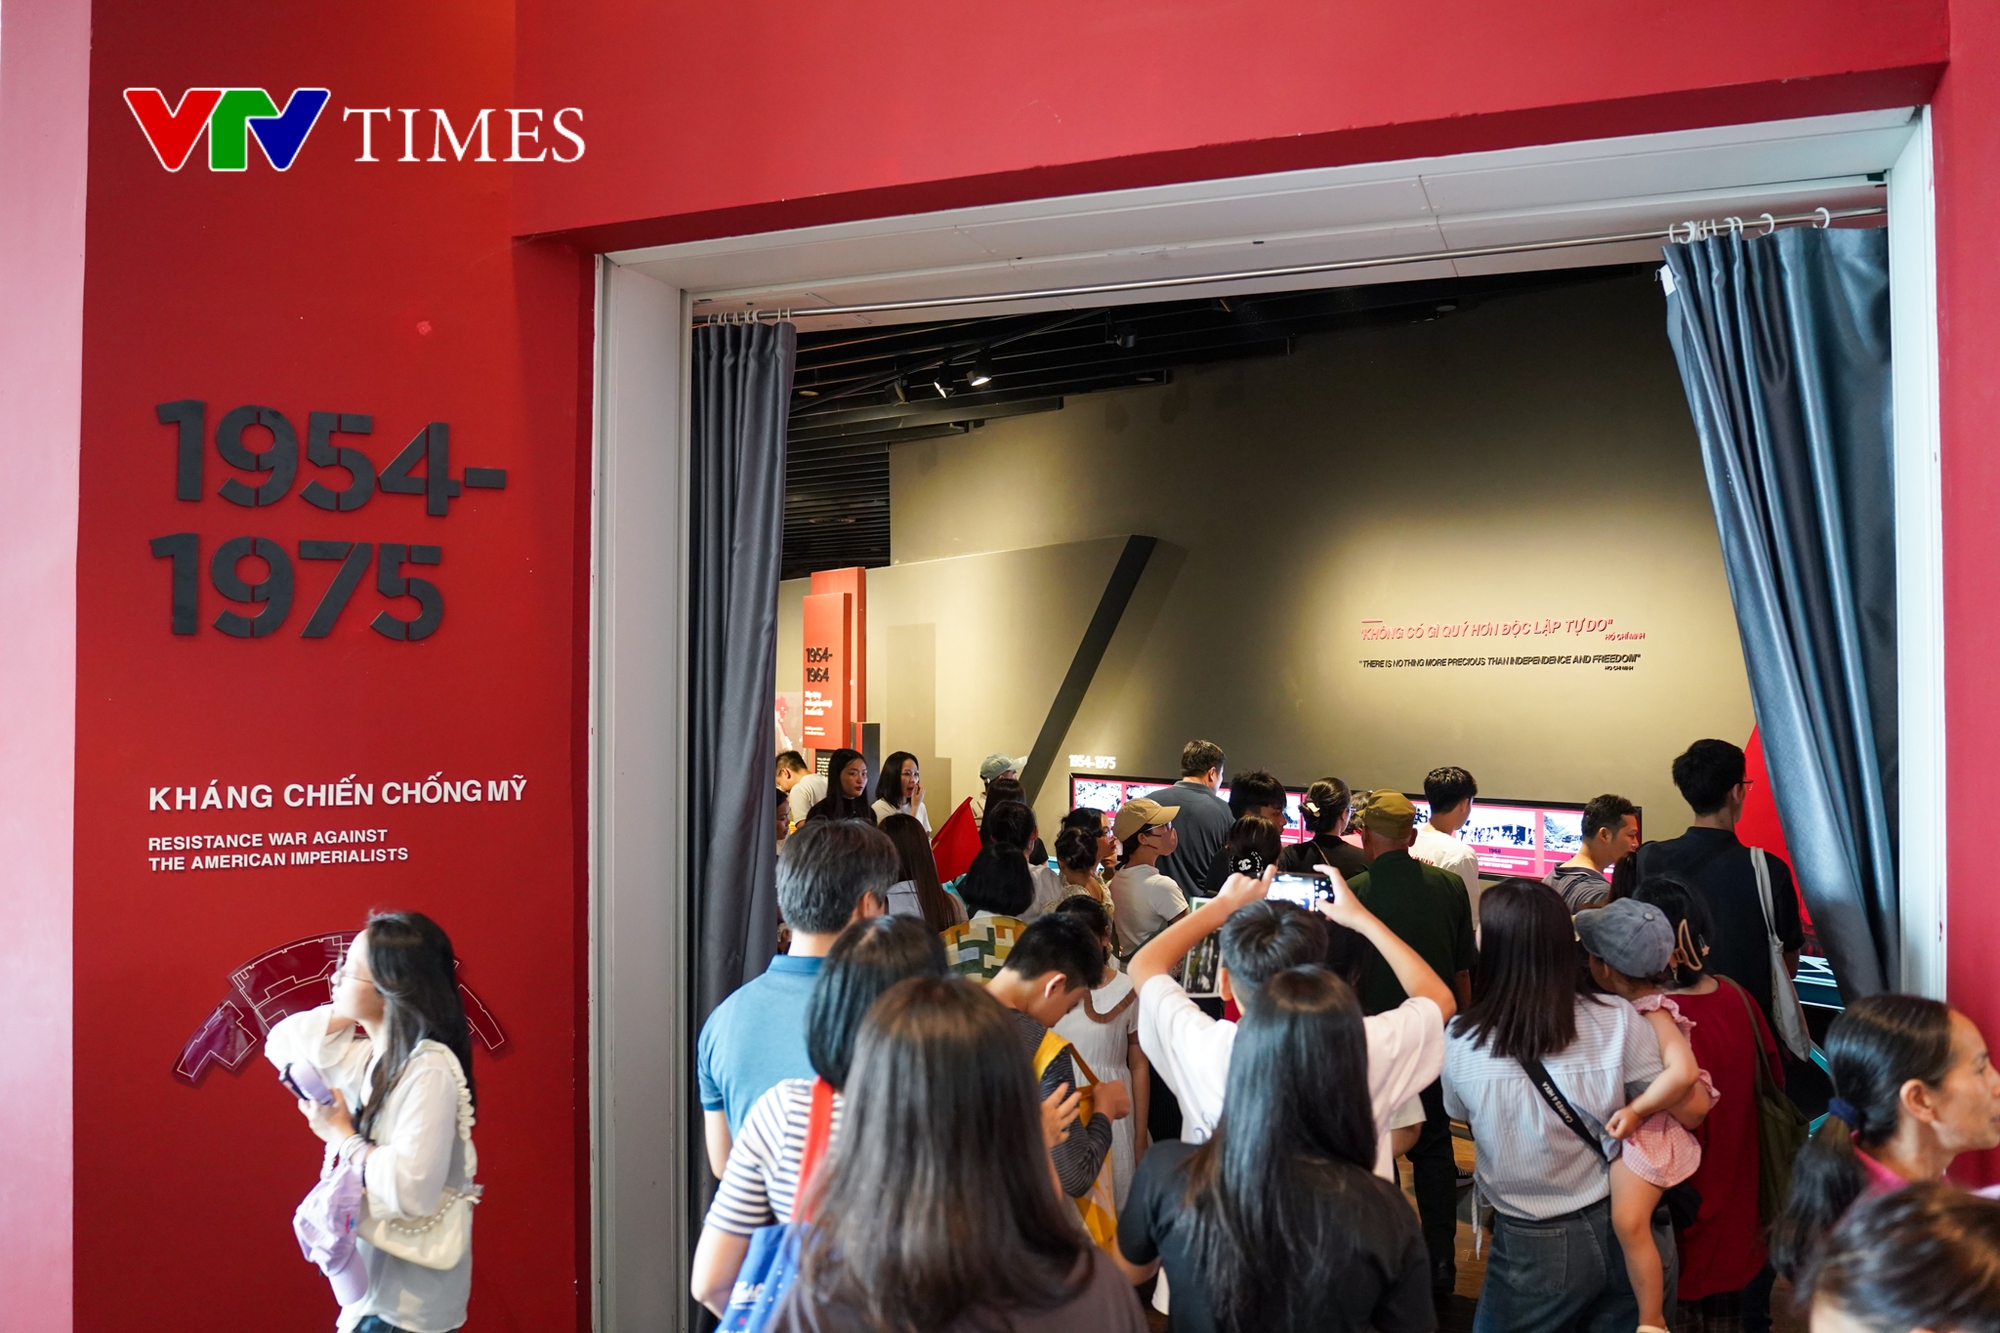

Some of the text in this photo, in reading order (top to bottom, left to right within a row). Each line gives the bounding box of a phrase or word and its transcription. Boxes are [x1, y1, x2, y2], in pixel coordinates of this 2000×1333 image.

[156, 399, 507, 517] 1954-
[150, 532, 444, 641] 1975
[1406, 623, 1424, 639] CÓ
[1442, 621, 1469, 638] QUÝ
[1501, 620, 1531, 638] ĐỘC
[1533, 619, 1562, 636] LẬP
[1565, 618, 1586, 636] TỰ
[1385, 660, 1392, 668] IS
[1393, 659, 1425, 668] NOTHING
[1425, 658, 1447, 667] MORE
[1447, 657, 1486, 667] PRECIOUS
[1487, 657, 1509, 666] THAN
[1509, 655, 1572, 666] INDEPENDENCE
[1572, 655, 1592, 665] AND
[806, 667, 829, 682] 1964
[1069, 754, 1117, 770] 1954-1975
[149, 771, 528, 811] KHÁNG CHIẾN CHỐNG MỸ
[148, 829, 388, 851] RESISTANCE WAR AGAINST
[149, 847, 409, 872] THE AMERICAN IMPERIALISTS
